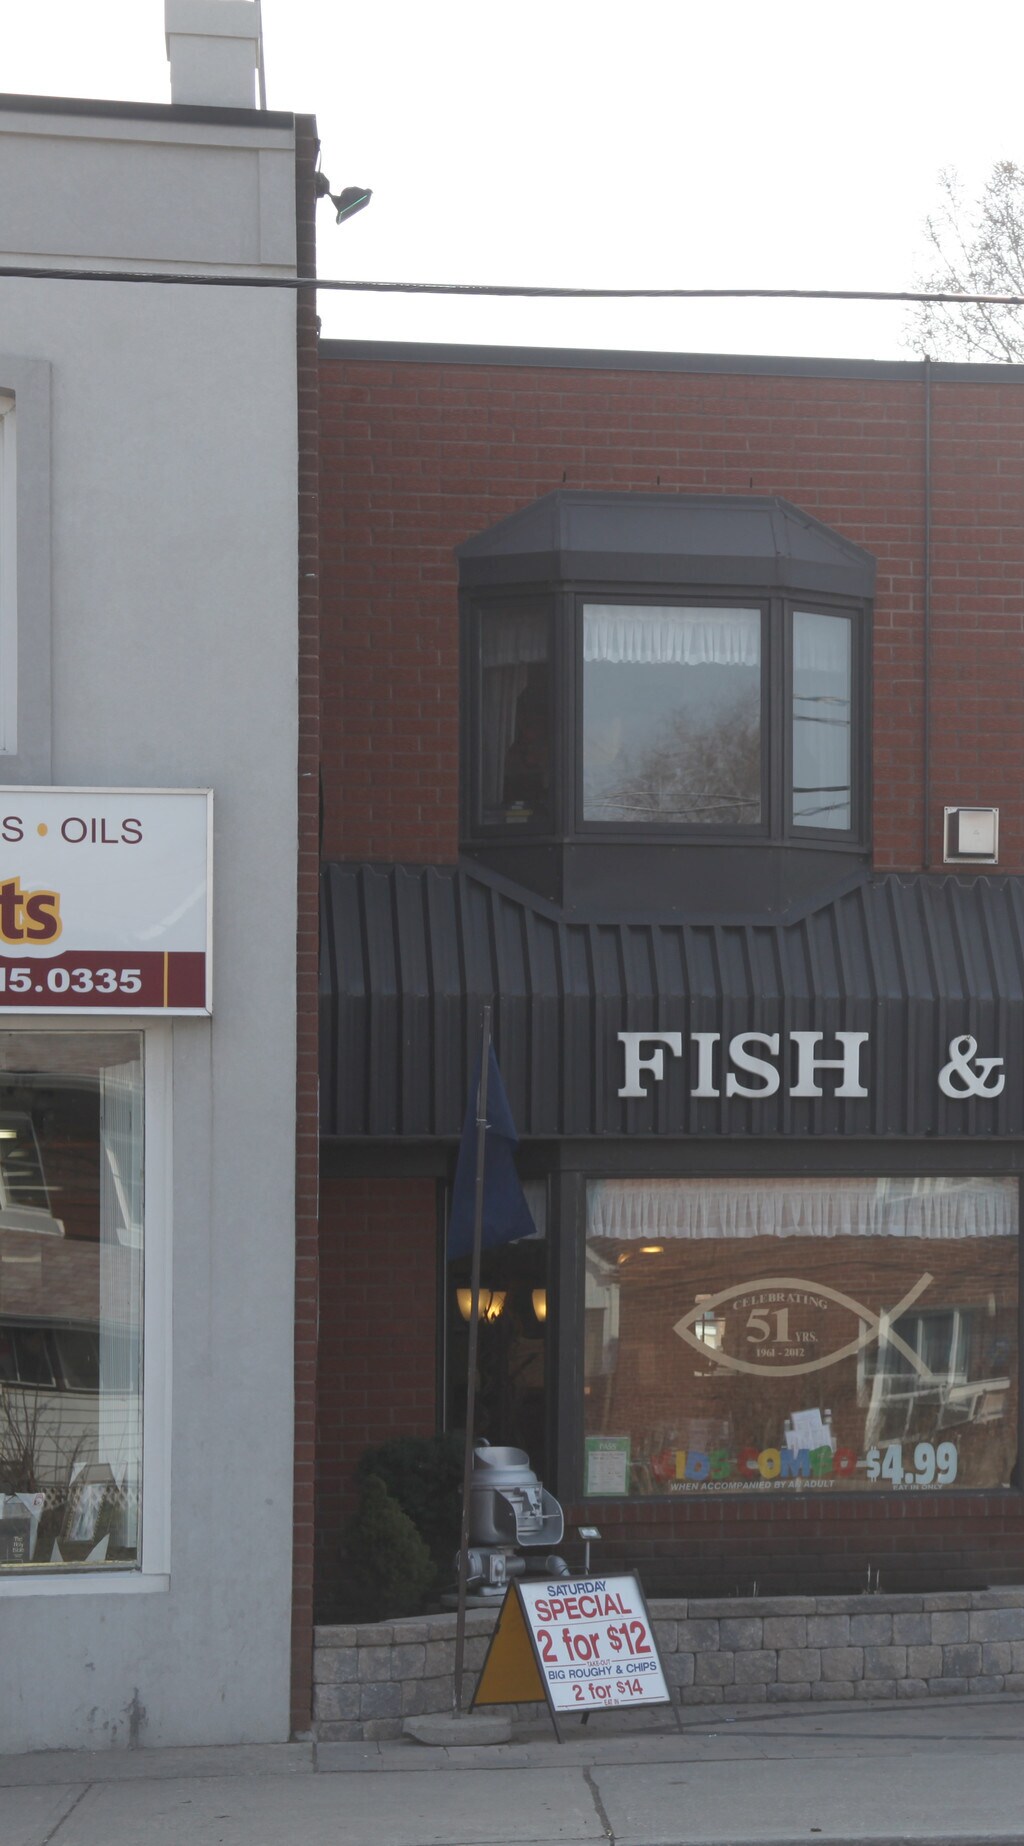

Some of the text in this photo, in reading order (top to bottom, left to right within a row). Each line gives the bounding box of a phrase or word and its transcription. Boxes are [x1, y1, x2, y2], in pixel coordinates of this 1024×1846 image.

[1, 816, 143, 844] S OILS
[0, 881, 58, 941] ts
[617, 1031, 869, 1098] FISH
[938, 1034, 1006, 1099] &
[732, 1292, 828, 1310] CELEBRATING
[746, 1307, 818, 1343] 51 YRS.
[756, 1348, 775, 1358] 1961
[784, 1348, 805, 1357] 2012
[650, 1448, 731, 1483] KIDS
[737, 1445, 858, 1480] COMBO
[866, 1441, 958, 1485] $4.99
[670, 1479, 835, 1491] WHEN ACCOMPANIED BY AN ADULT
[547, 1581, 607, 1597] SATURDAY
[535, 1593, 632, 1622] SPECIAL
[537, 1620, 652, 1663] 2 for $12
[548, 1661, 657, 1680] BIG ROUGHY & CHIPS
[572, 1678, 644, 1701] 2 for $14
